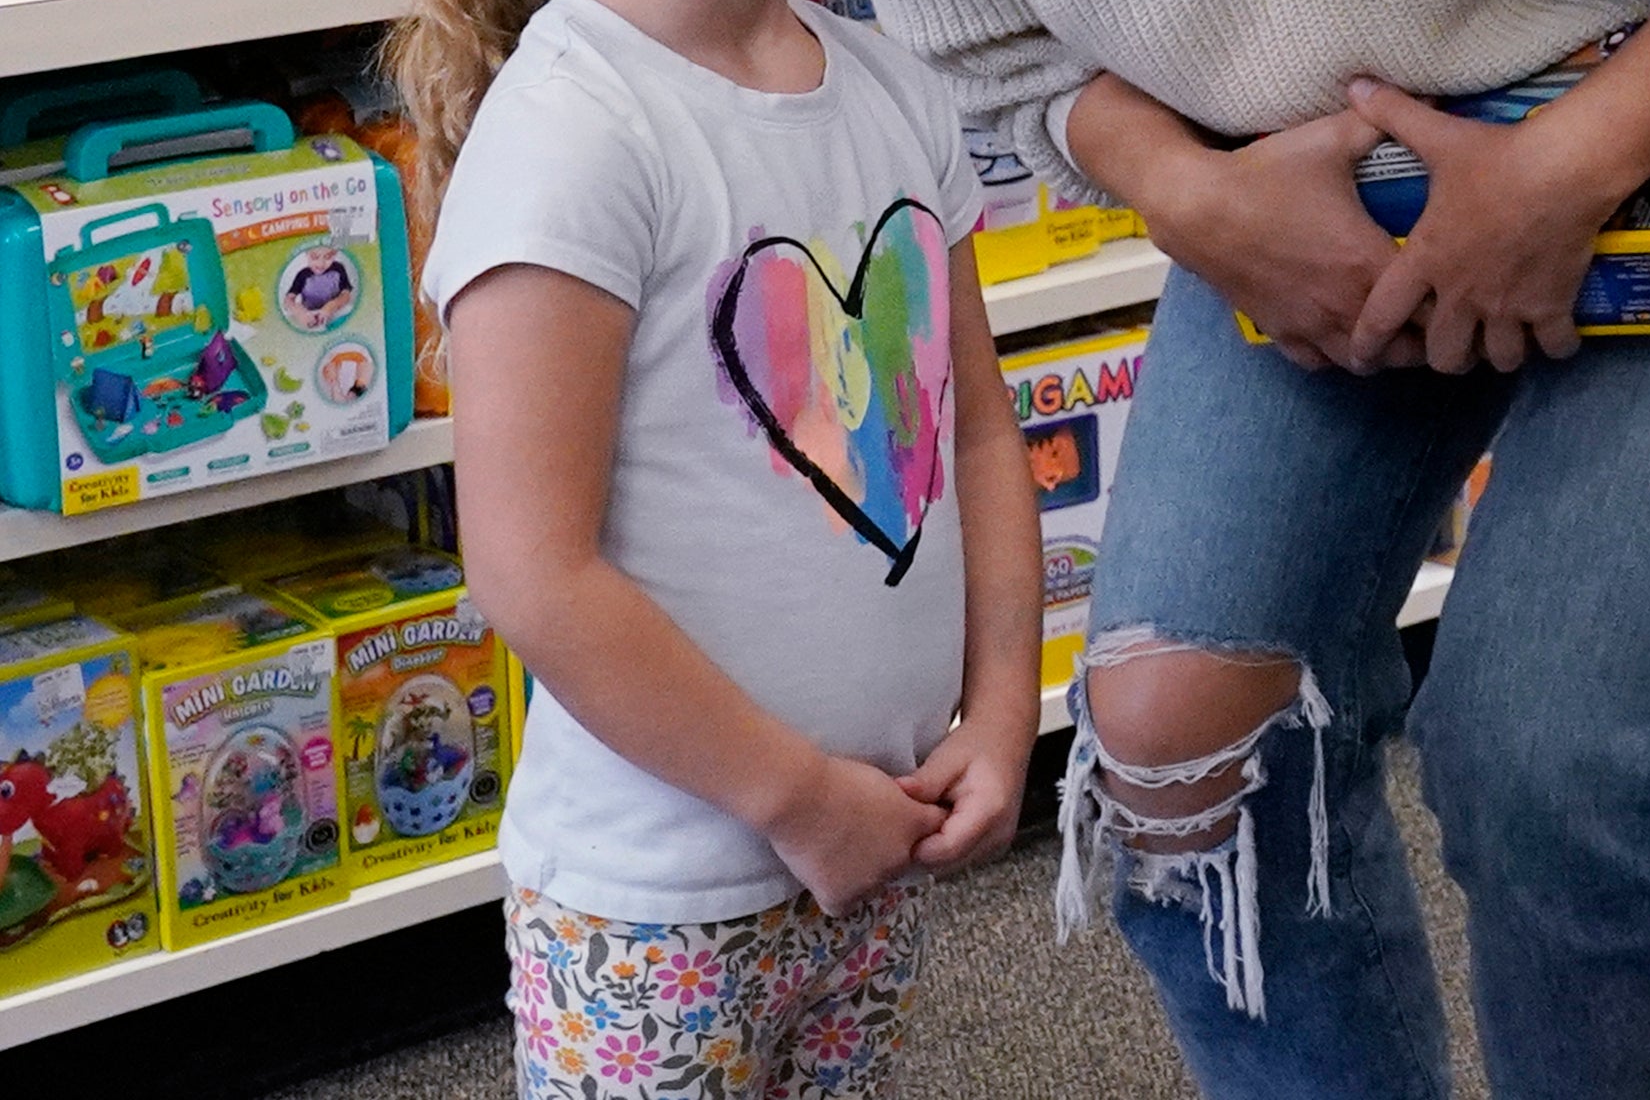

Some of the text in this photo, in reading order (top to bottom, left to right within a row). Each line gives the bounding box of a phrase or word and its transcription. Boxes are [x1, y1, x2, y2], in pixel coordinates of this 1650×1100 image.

[212, 175, 367, 219] Sensory on the Go
[260, 214, 310, 238] CAMPING
[67, 471, 131, 496] Creativity
[345, 631, 400, 676] MINI
[171, 679, 228, 729] MINI
